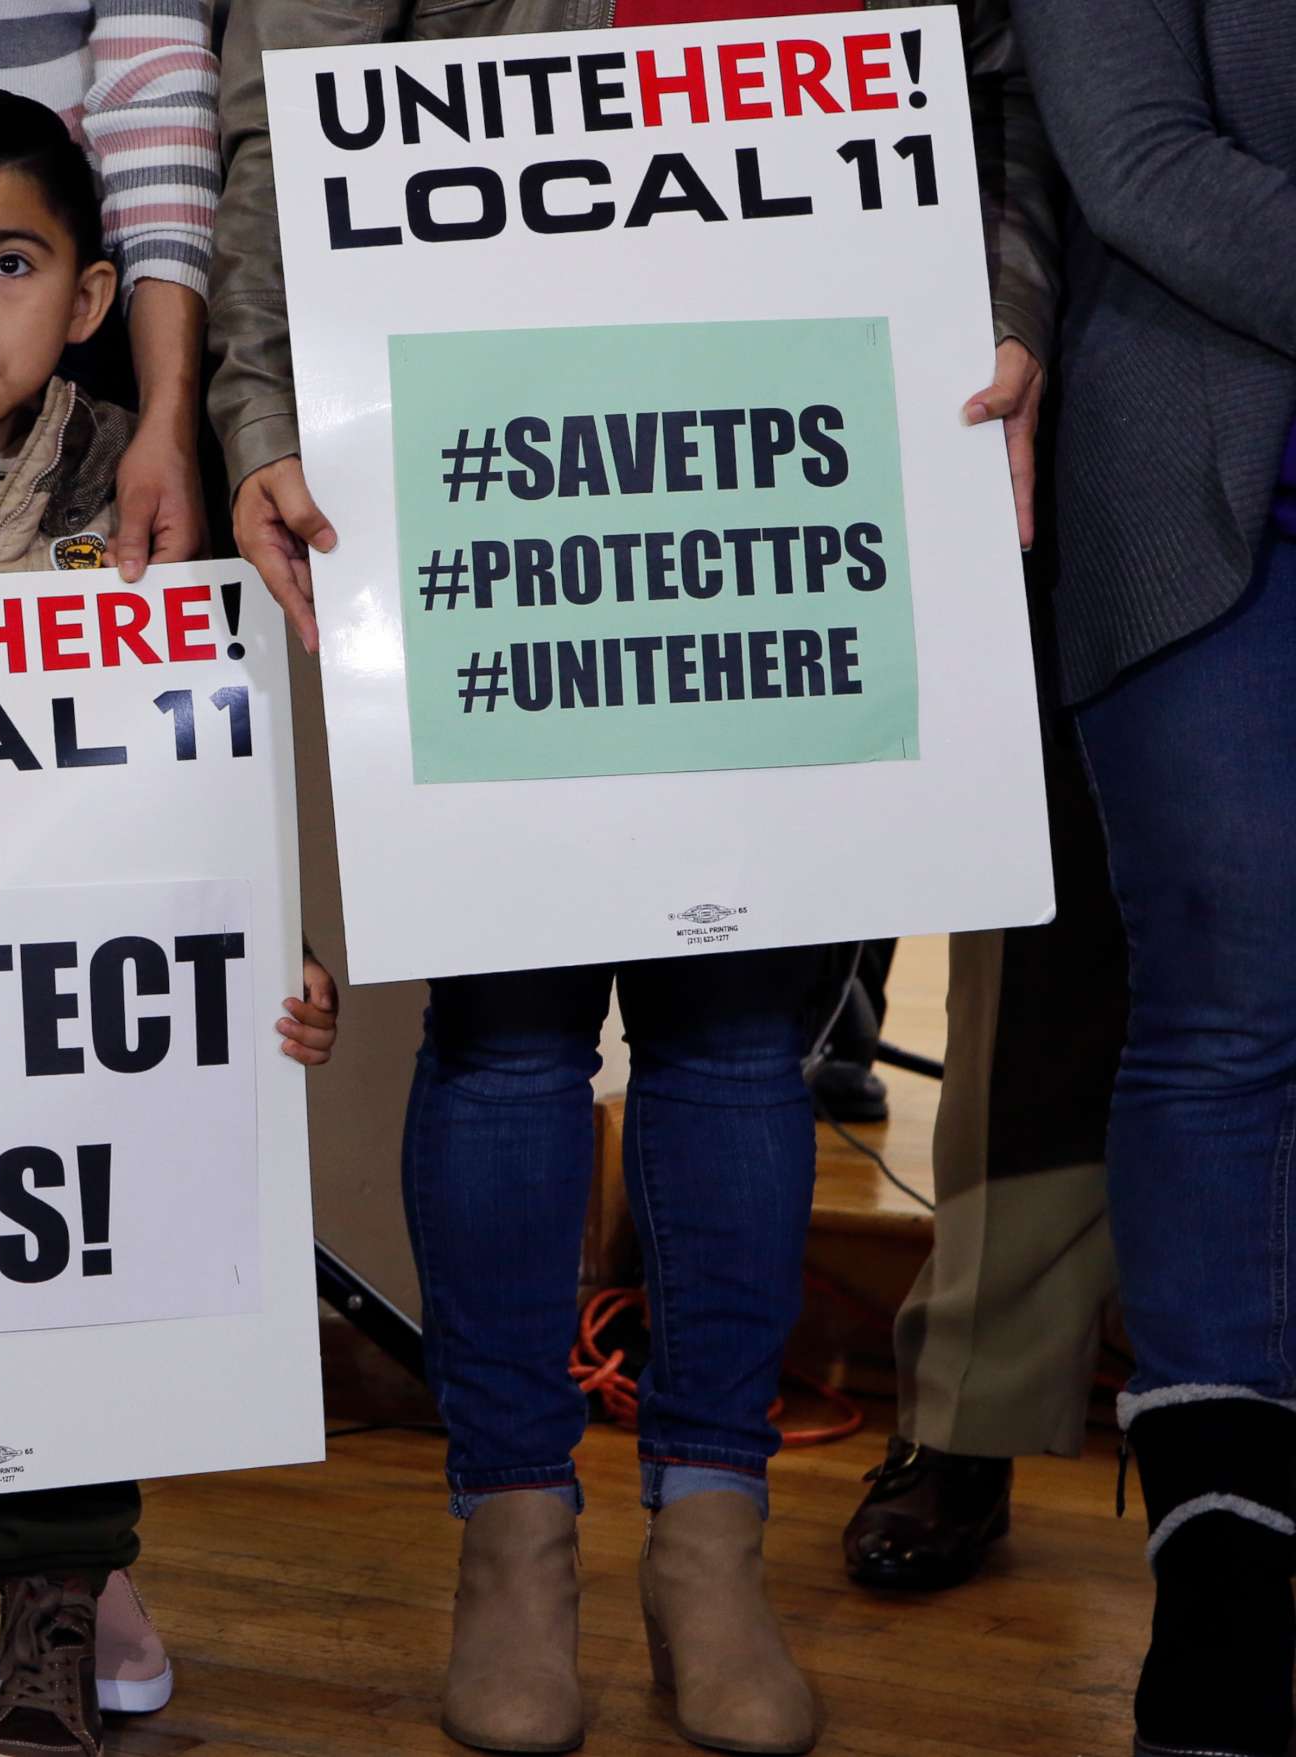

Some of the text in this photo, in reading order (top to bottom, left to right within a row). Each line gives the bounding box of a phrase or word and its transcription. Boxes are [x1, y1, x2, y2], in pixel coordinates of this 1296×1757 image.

[324, 135, 938, 250] LOCAL 11
[442, 405, 848, 502] #SAVETPS
[419, 522, 886, 610] #PROTECTTPS
[458, 627, 862, 713] #UNITEHERE
[153, 686, 253, 760] 11
[676, 925, 739, 936] MITCHELL PRINTING
